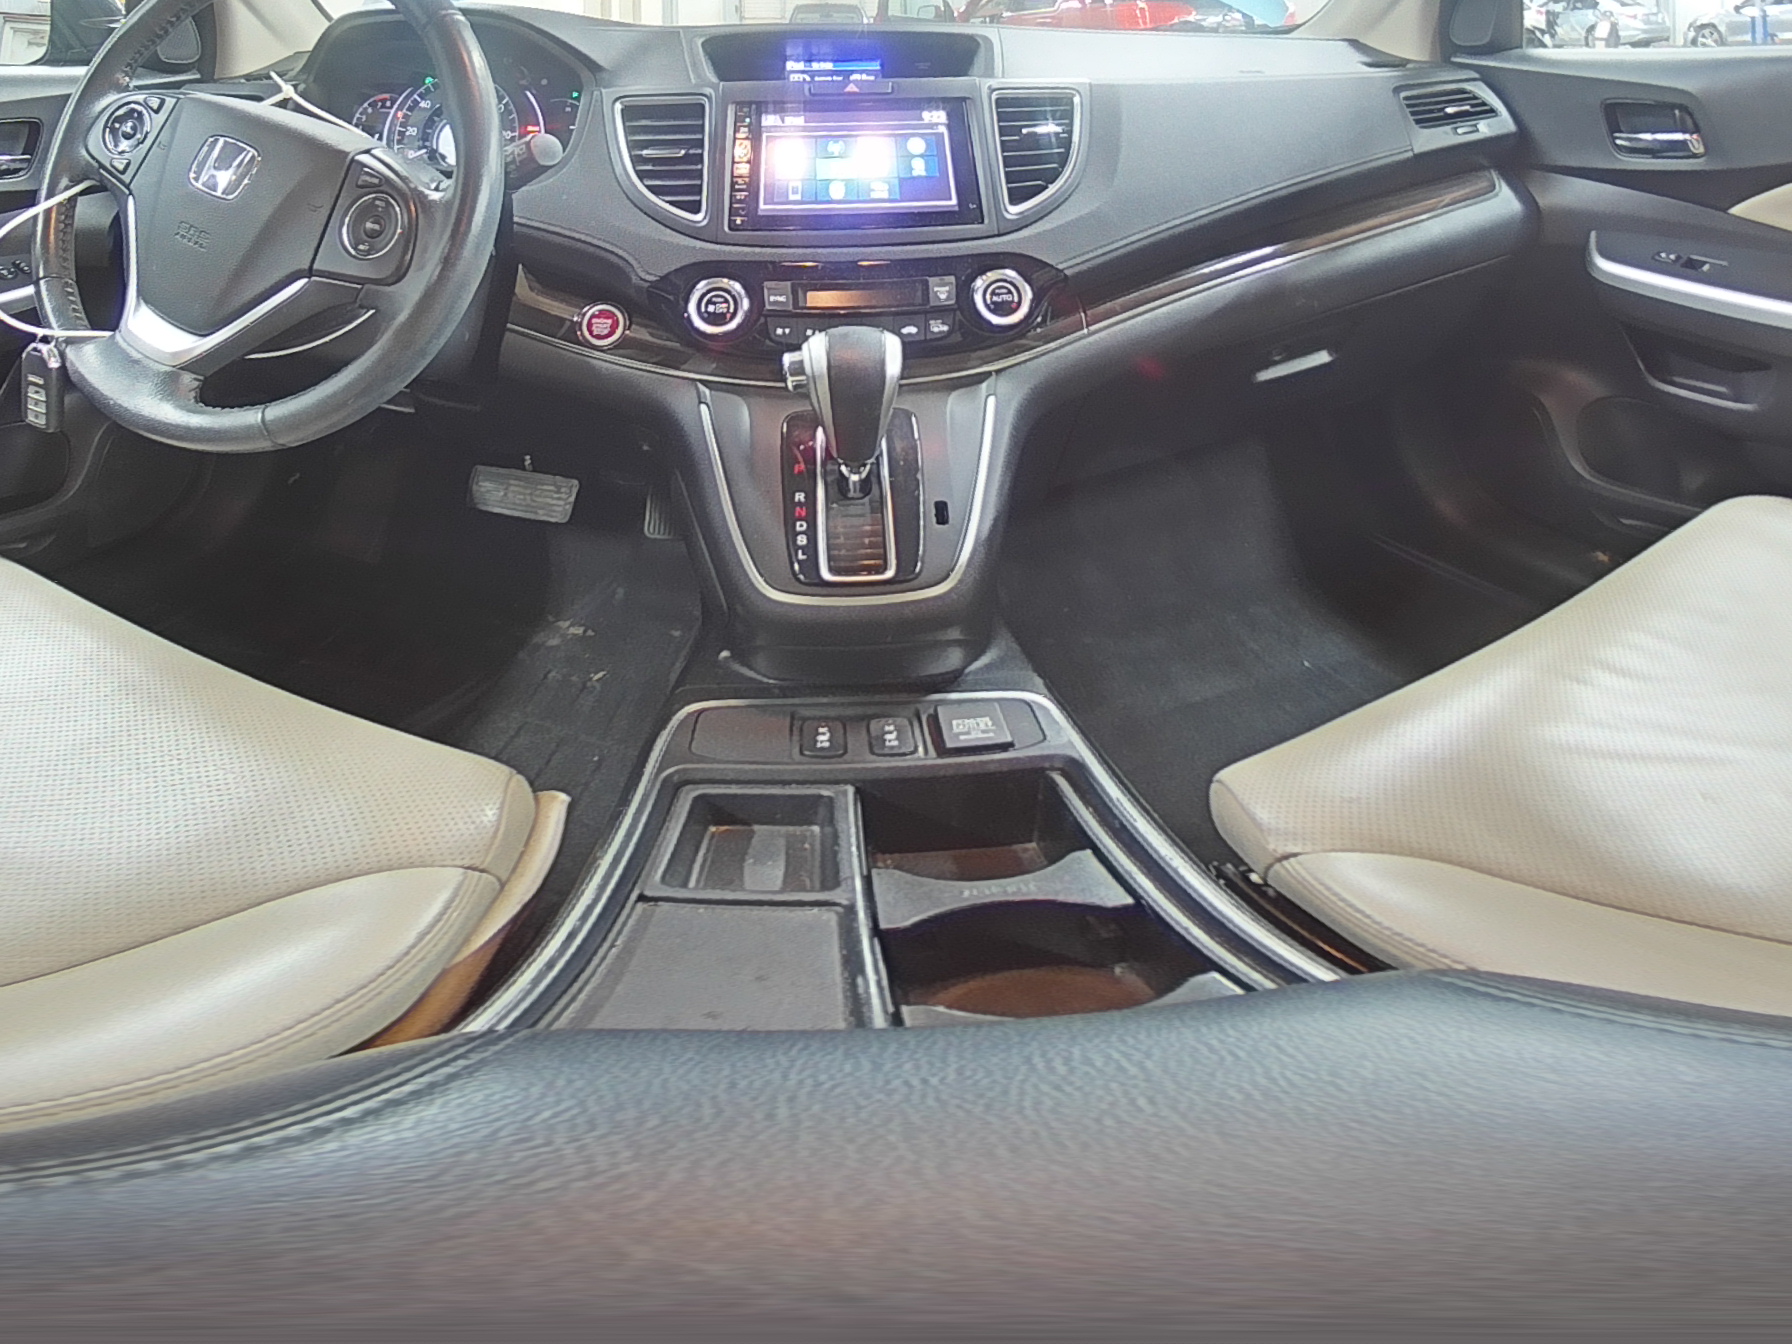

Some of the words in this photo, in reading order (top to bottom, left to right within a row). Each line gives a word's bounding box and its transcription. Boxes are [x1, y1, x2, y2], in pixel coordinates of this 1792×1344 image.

[419, 99, 431, 108] 40
[405, 126, 418, 136] 20
[992, 294, 1013, 302] AUTO
[794, 492, 806, 503] R
[795, 507, 806, 517] N
[795, 521, 807, 532] D
[796, 534, 808, 546] S
[797, 549, 807, 560] L
